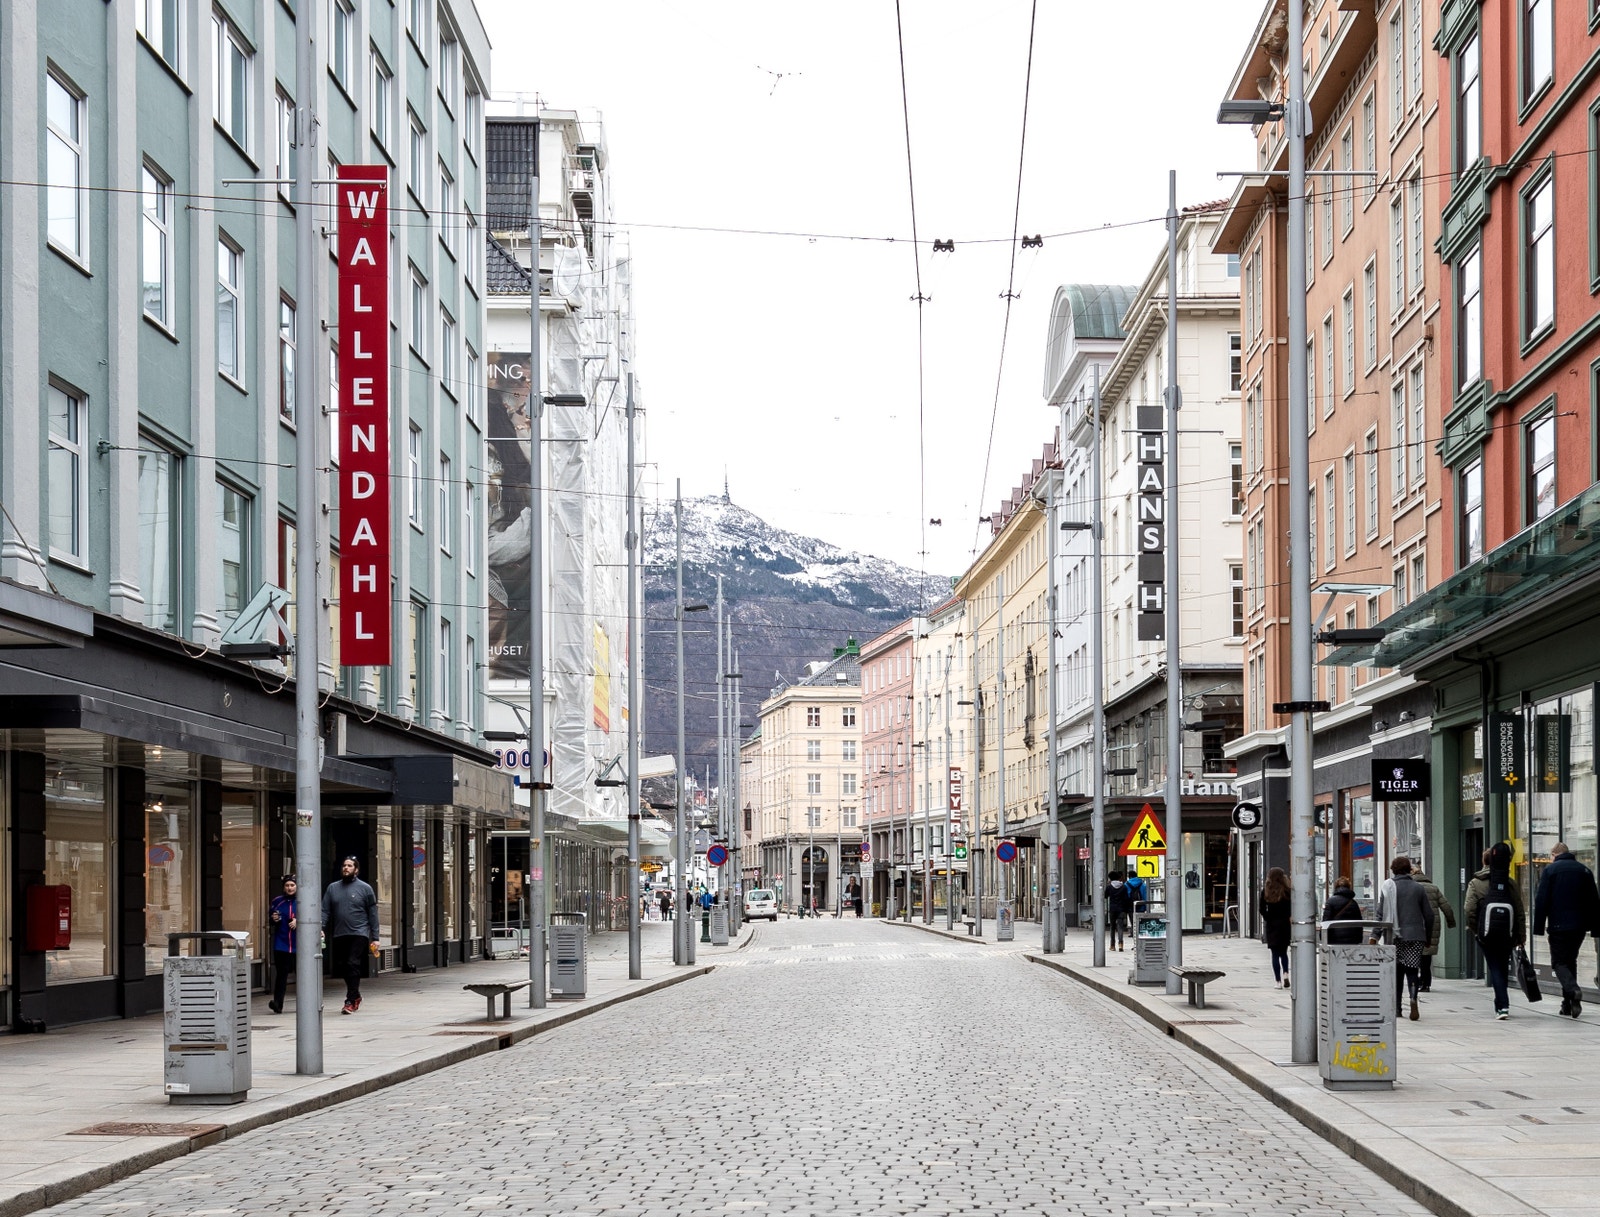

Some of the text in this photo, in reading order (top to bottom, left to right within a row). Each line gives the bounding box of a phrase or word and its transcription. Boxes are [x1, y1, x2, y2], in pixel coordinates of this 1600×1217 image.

[487, 363, 524, 380] ING
[346, 191, 379, 640] WALLENDAHL
[1139, 437, 1163, 550] HANS
[1500, 722, 1508, 777] SOUNDGARDEN
[1506, 722, 1514, 772] SPACEWORLD
[950, 769, 962, 834] BEYER
[1379, 780, 1419, 789] TIGER
